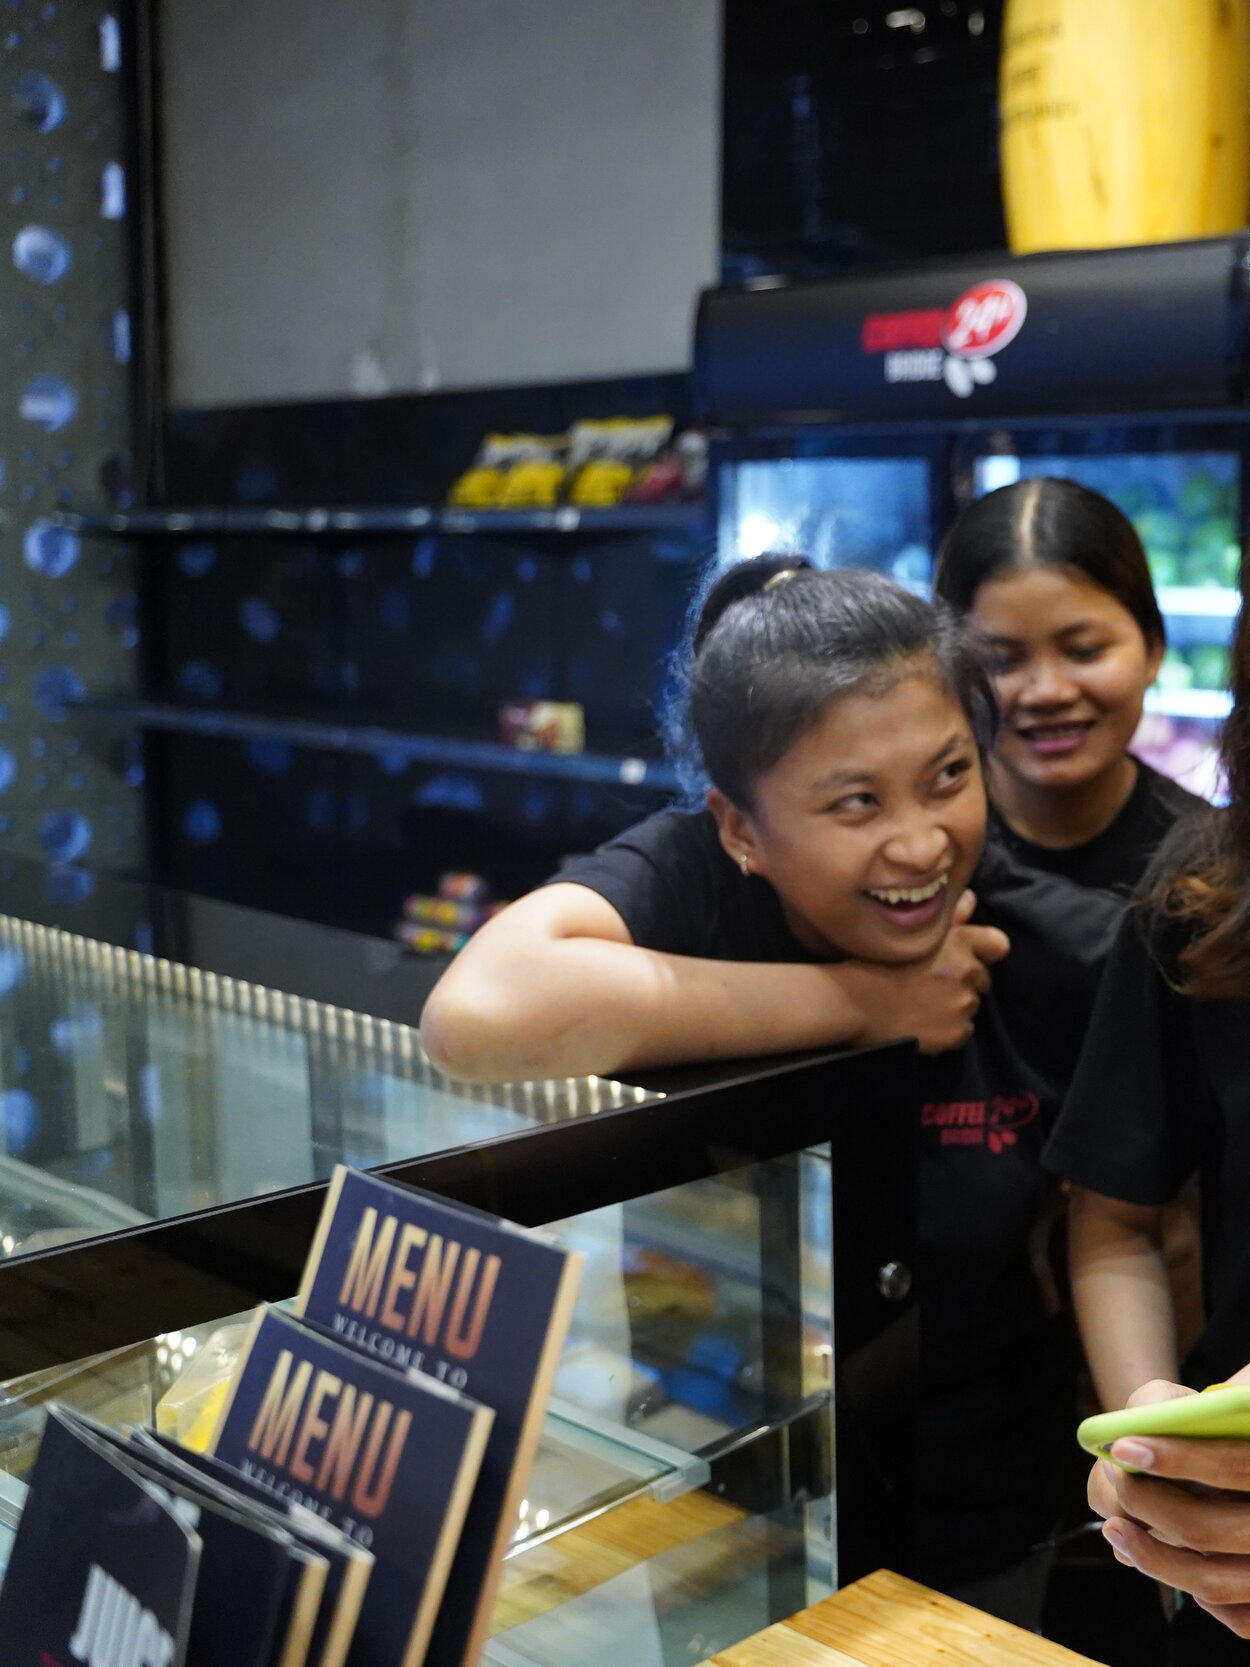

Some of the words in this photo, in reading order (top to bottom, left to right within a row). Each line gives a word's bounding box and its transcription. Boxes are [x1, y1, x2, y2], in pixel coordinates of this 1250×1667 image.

[338, 1206, 502, 1363] MENU
[332, 1313, 426, 1370] WELCOME
[436, 1360, 468, 1390] TO
[247, 1349, 413, 1519] MENU
[342, 1517, 374, 1550] TO
